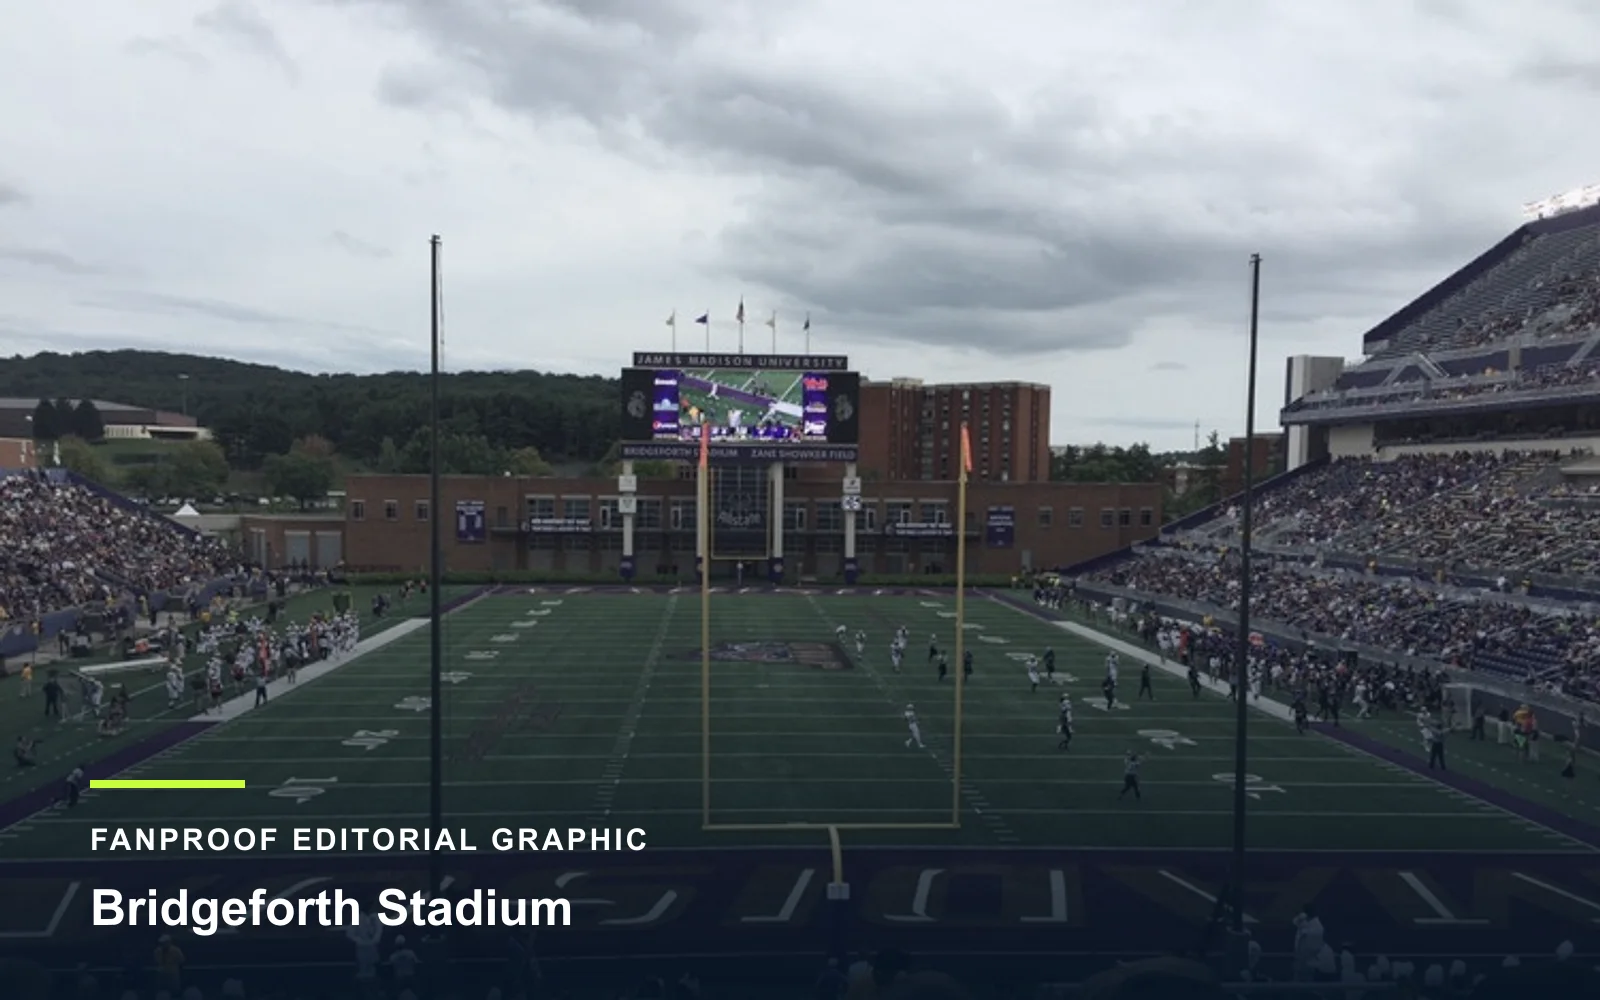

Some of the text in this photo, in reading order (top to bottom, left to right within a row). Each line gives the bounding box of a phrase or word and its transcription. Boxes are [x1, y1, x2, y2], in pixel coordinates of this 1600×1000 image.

[637, 355, 844, 368] JAMES MADISON UNIVERSITY
[624, 446, 692, 457] BRIDGEFORTH
[751, 448, 856, 460] ZANE SHOWKER FIELD
